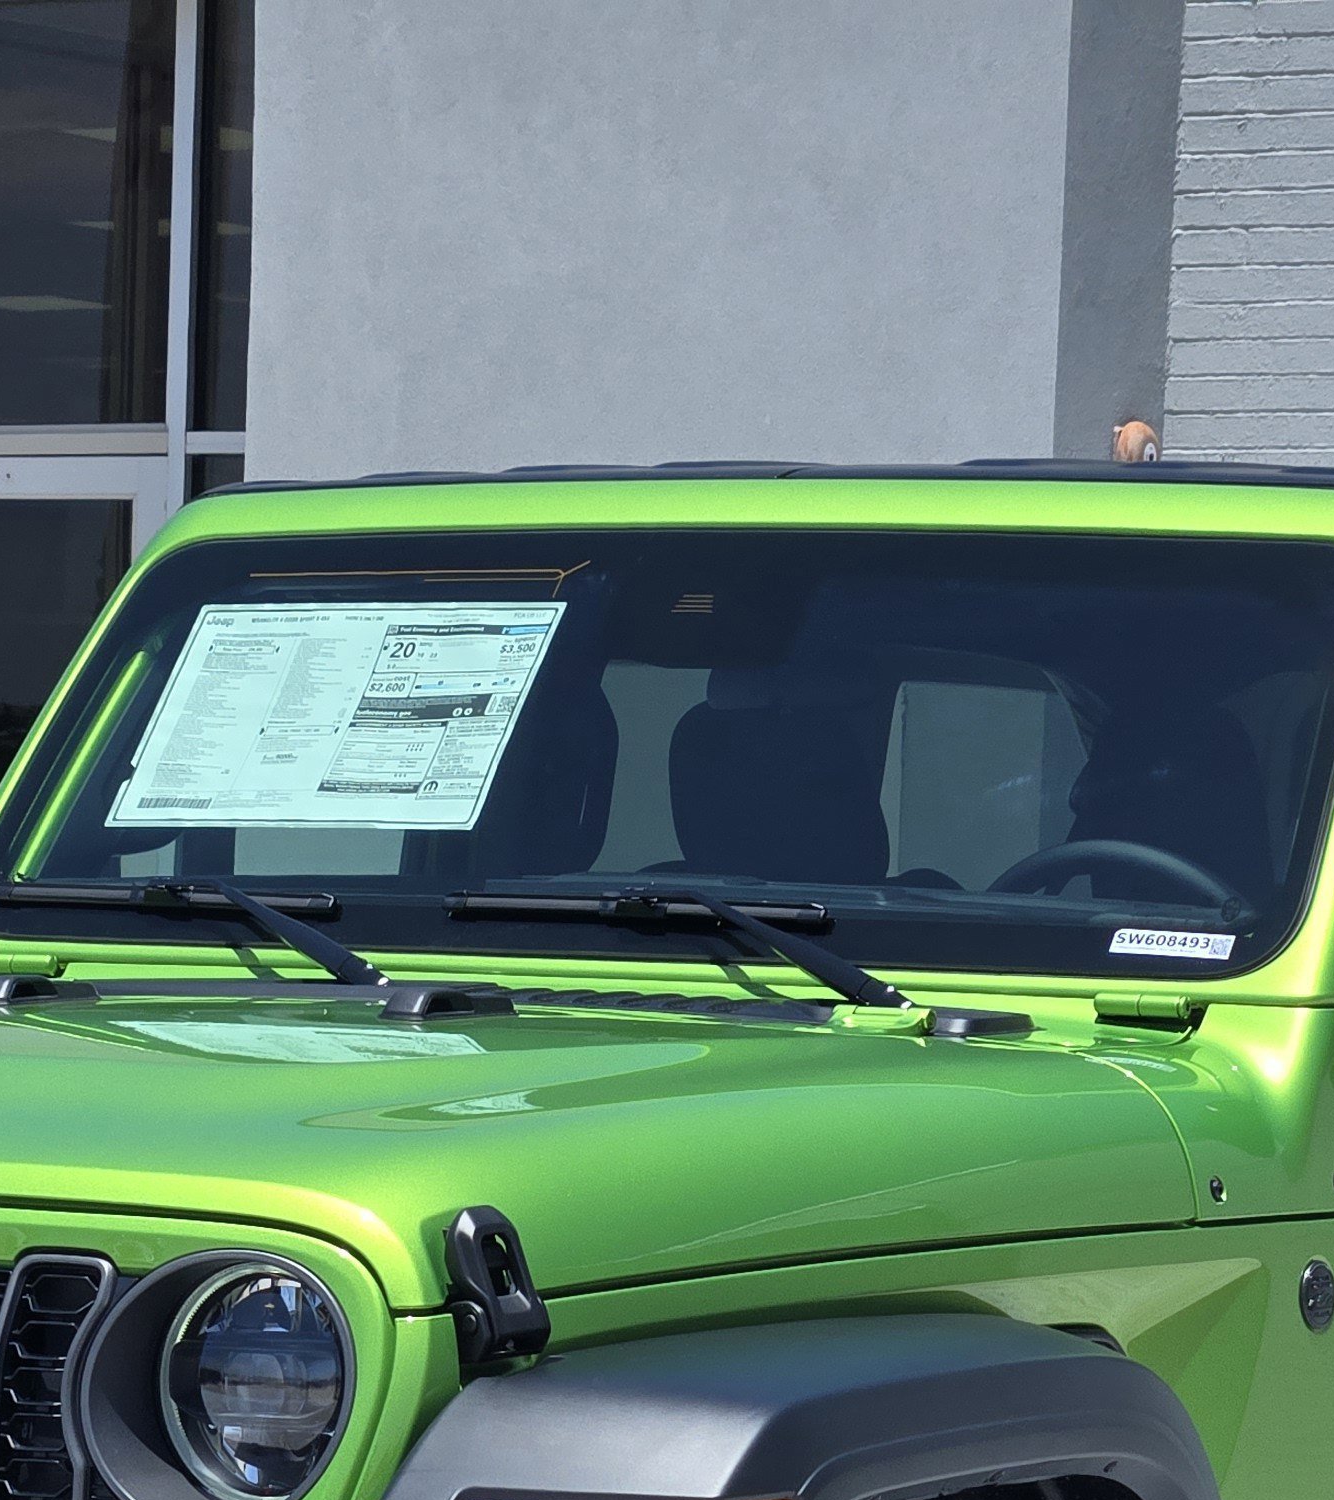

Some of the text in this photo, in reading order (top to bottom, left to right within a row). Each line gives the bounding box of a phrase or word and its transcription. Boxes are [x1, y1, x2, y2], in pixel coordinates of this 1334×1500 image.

[207, 616, 235, 627] Jeep
[389, 642, 416, 658] 20
[500, 643, 536, 654] $3,500
[368, 683, 406, 693] $2,600
[1115, 932, 1211, 949] SW608493
